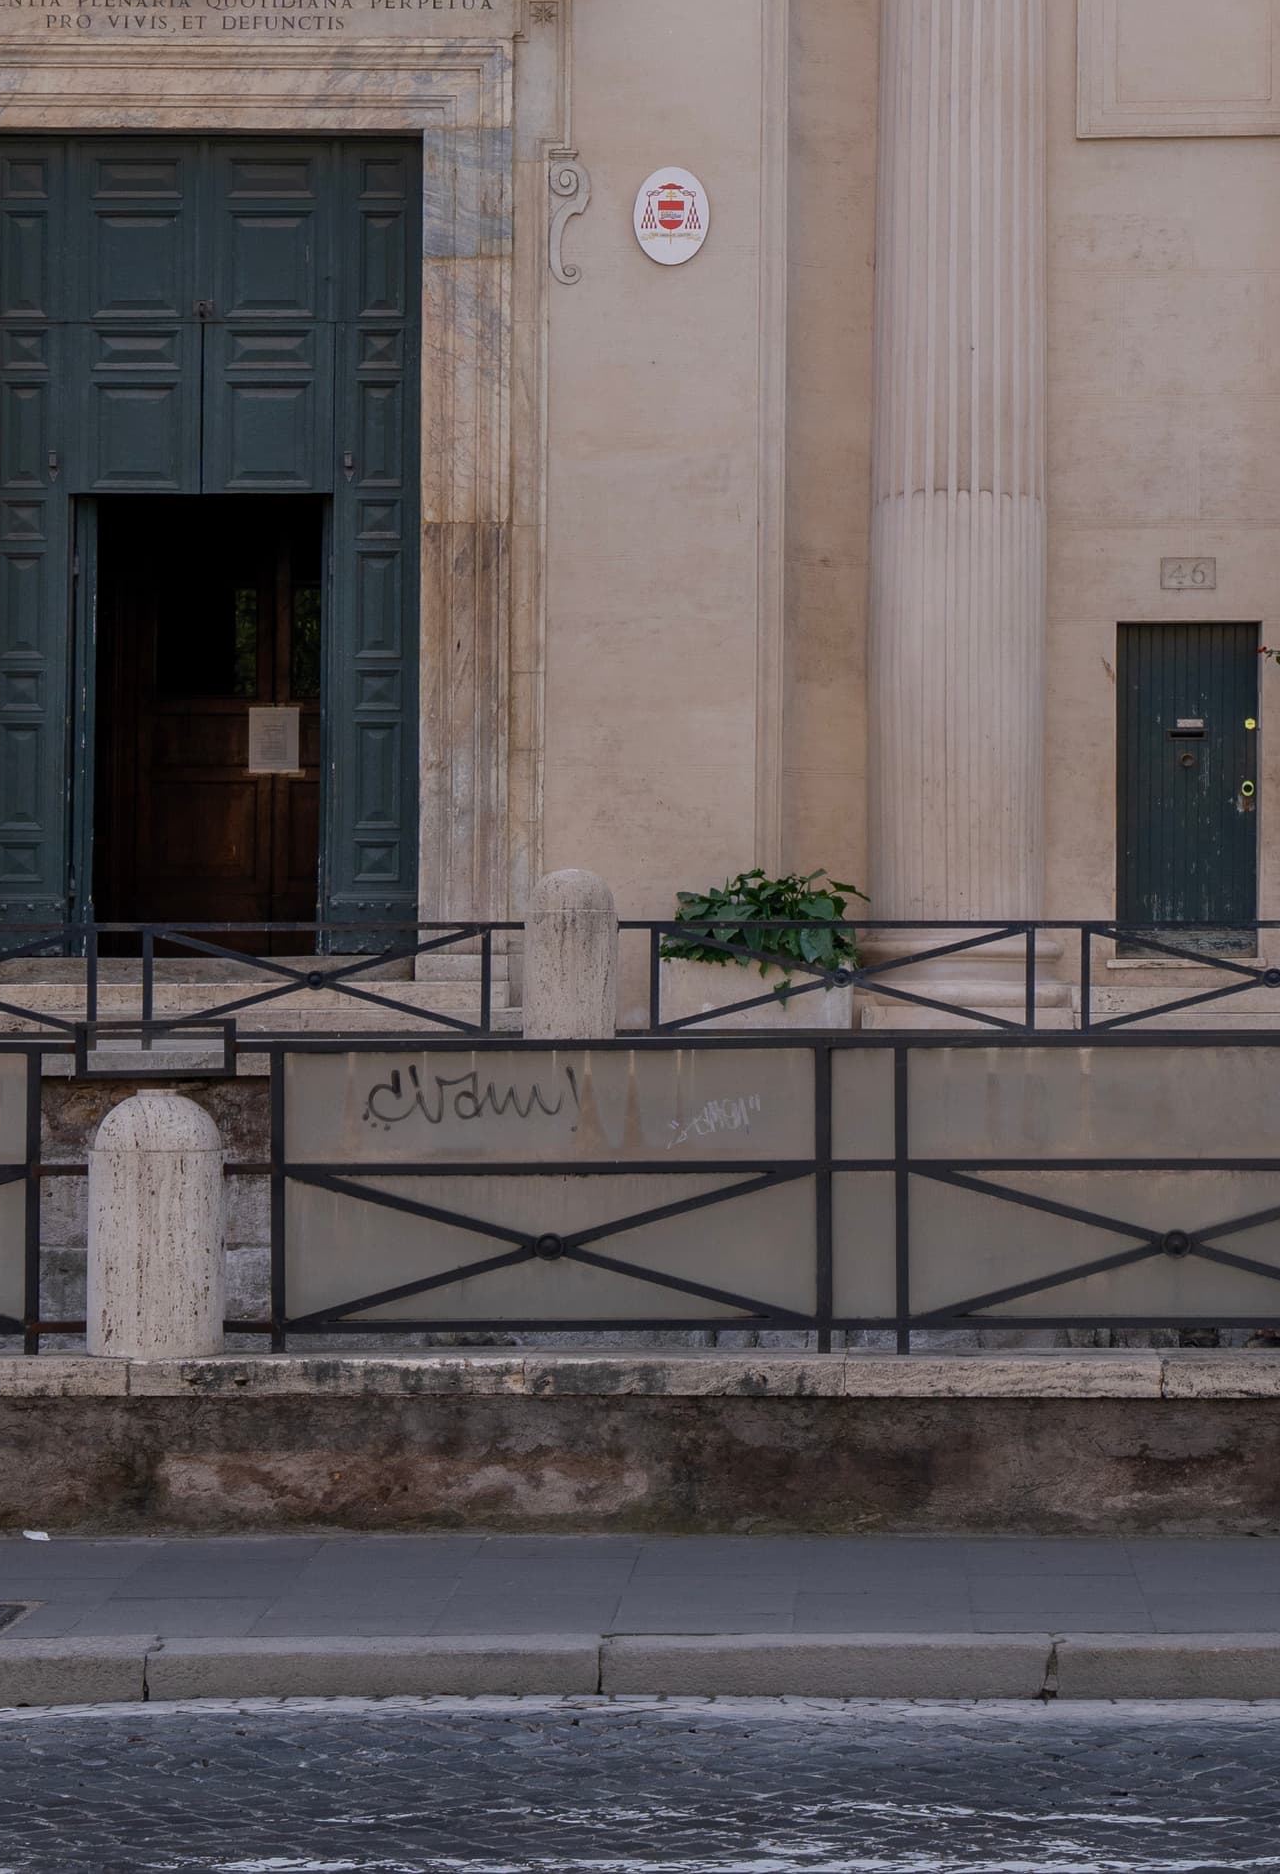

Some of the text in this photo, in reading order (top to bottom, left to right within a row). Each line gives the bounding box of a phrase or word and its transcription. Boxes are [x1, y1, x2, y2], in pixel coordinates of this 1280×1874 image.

[45, 14, 92, 30] PRO
[181, 15, 208, 30] ET
[221, 15, 346, 31] DEFUNCTIS
[1167, 563, 1207, 585] 46
